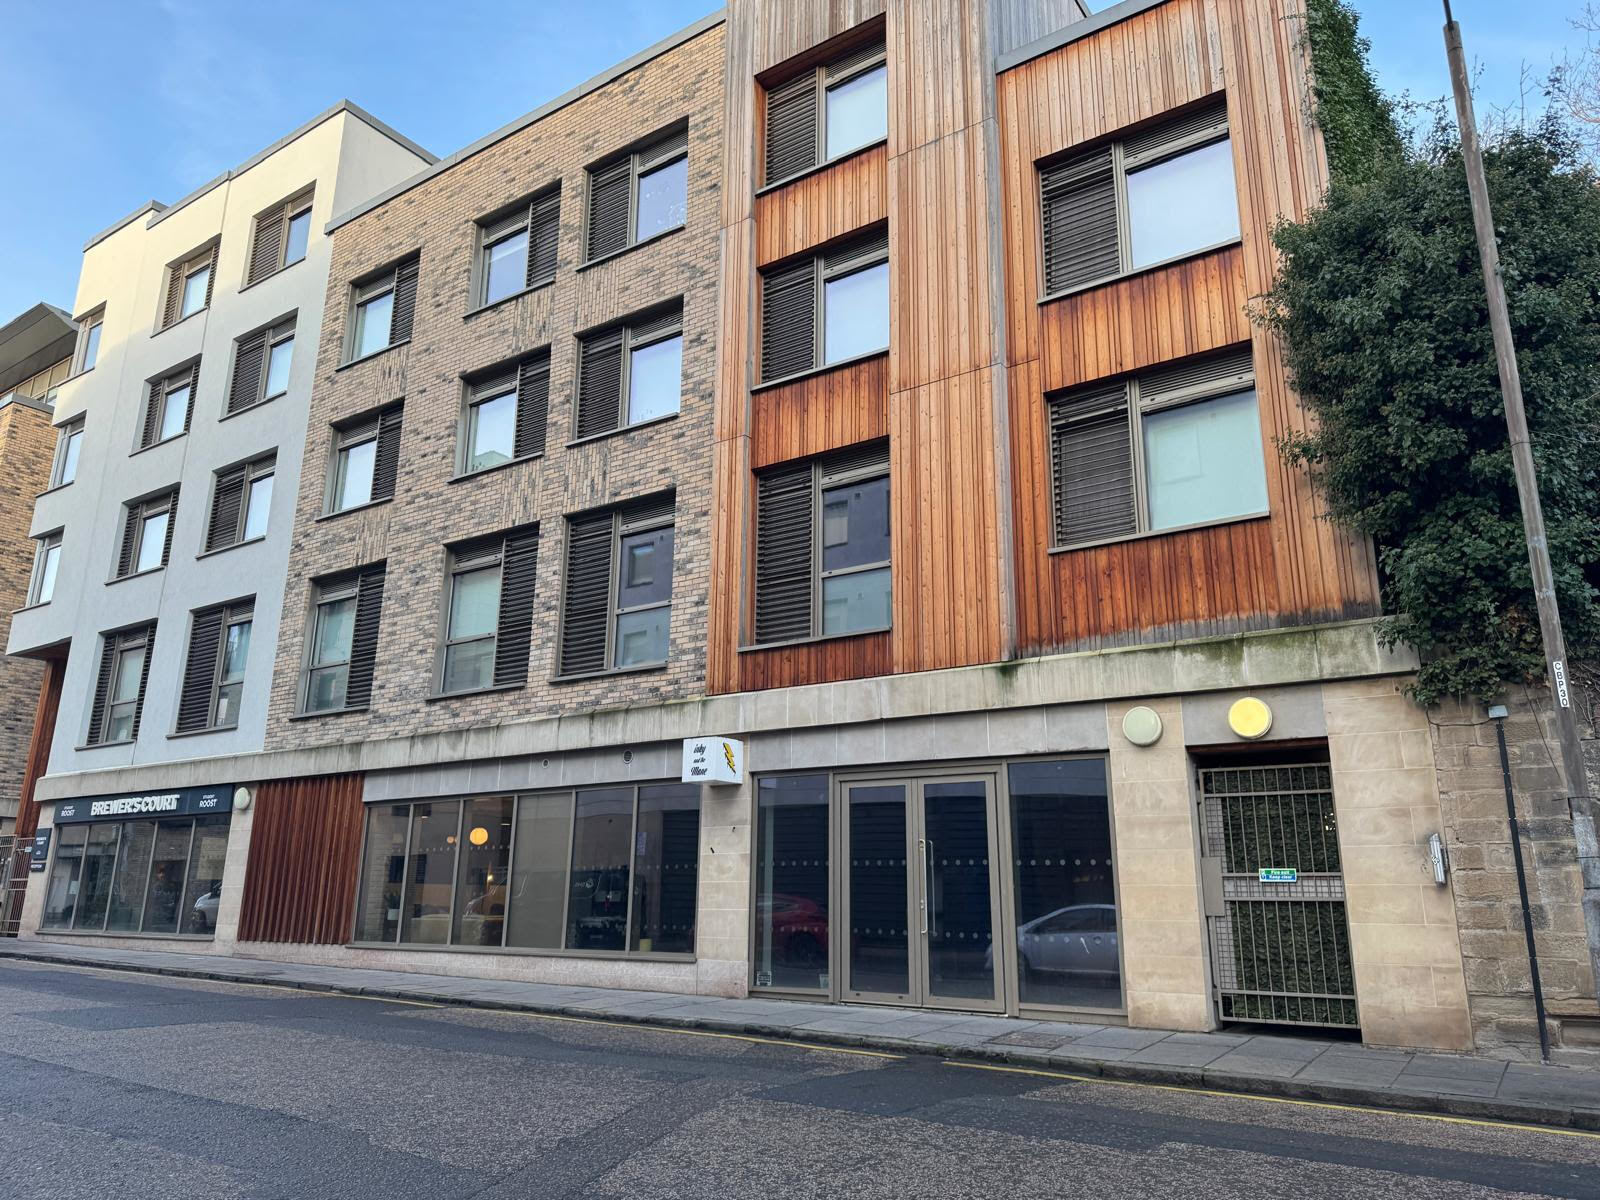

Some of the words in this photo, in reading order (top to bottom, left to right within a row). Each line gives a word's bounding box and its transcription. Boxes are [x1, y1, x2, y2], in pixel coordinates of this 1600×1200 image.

[1555, 662, 1568, 706] CBP30
[90, 797, 142, 816] BREWER'S
[141, 794, 180, 813] COURT
[199, 798, 217, 808] ROOST
